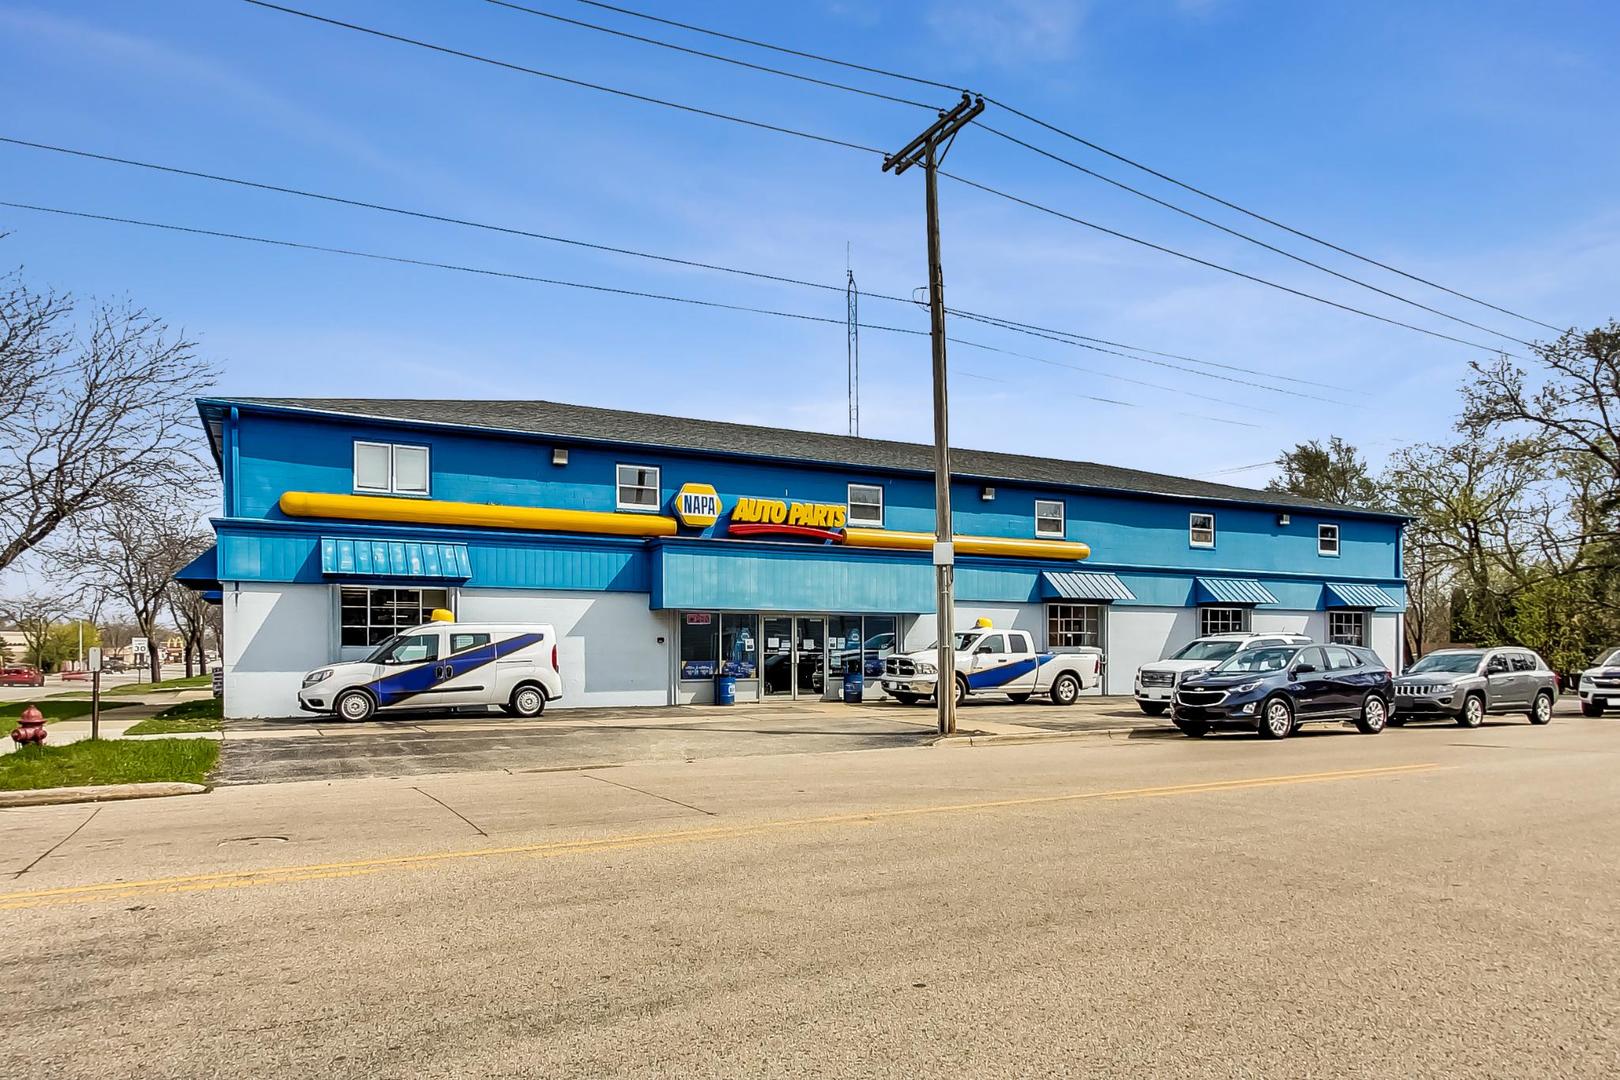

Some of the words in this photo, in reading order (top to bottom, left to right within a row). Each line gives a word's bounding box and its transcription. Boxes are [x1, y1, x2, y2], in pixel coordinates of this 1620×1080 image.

[684, 495, 716, 516] NAPA
[731, 497, 787, 524] AUTO
[788, 501, 847, 528] PARTS
